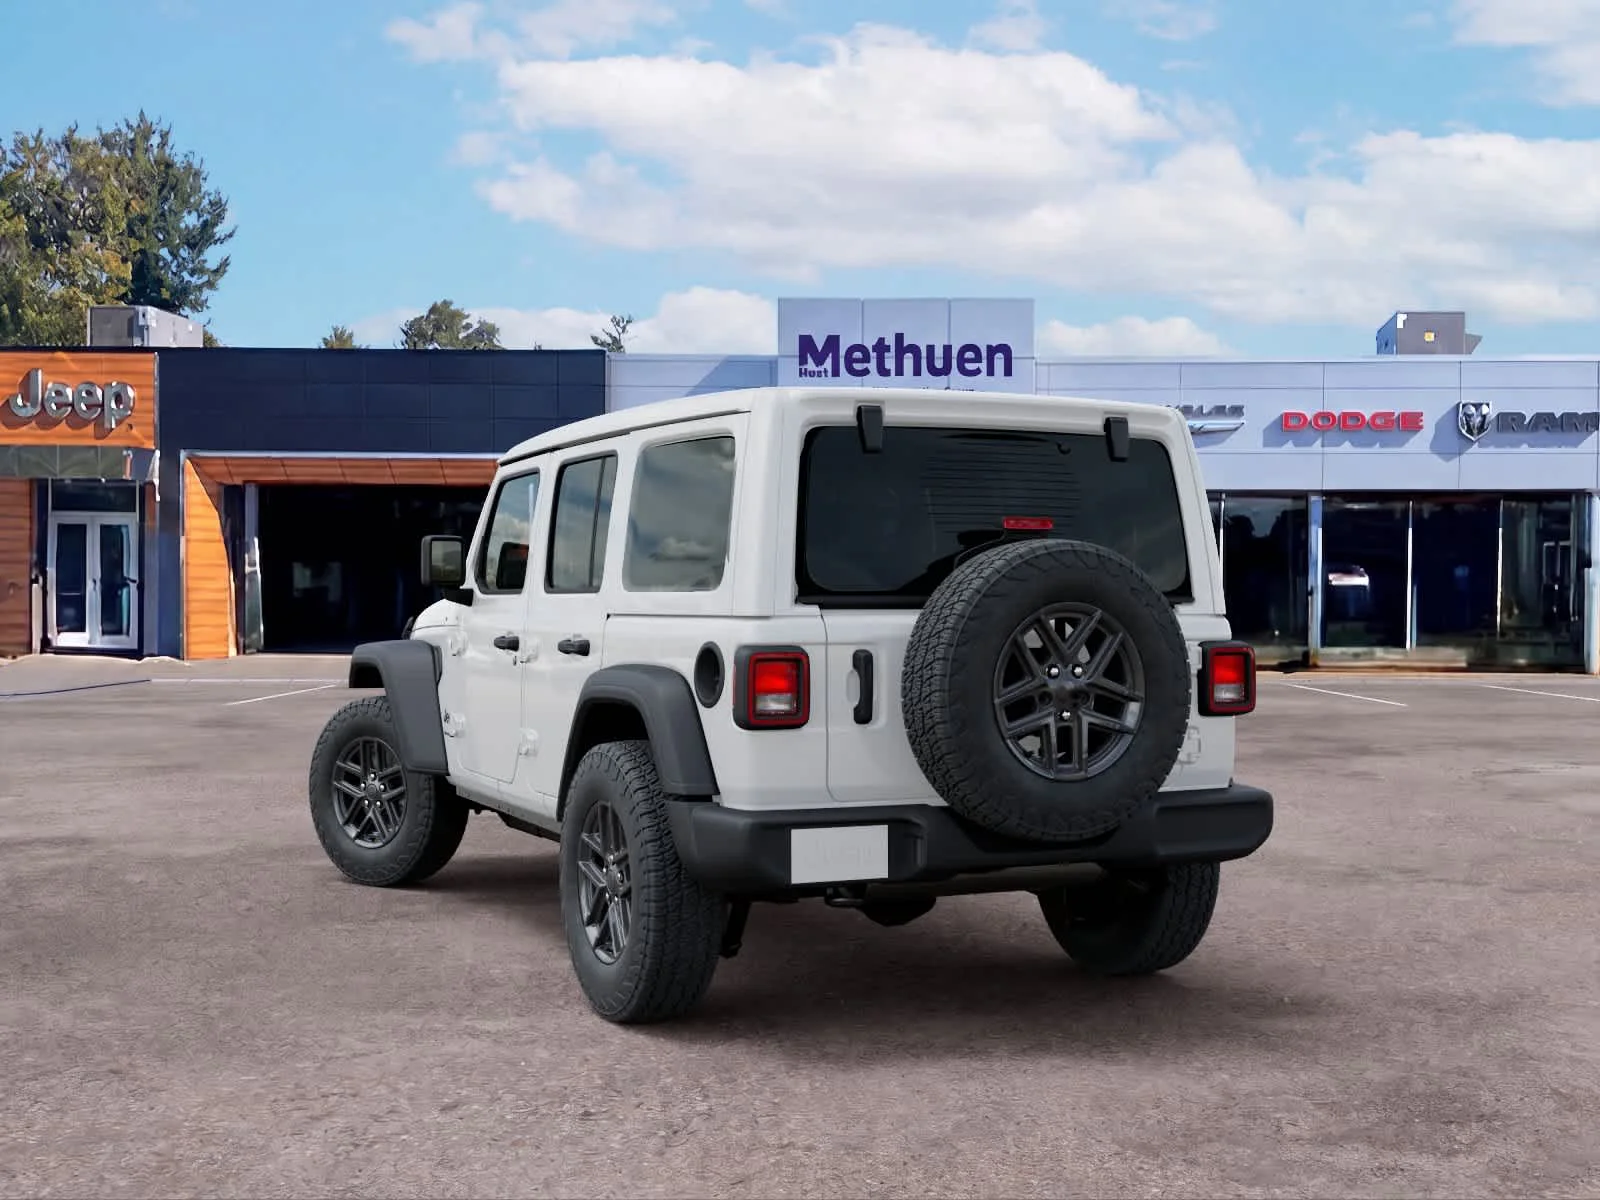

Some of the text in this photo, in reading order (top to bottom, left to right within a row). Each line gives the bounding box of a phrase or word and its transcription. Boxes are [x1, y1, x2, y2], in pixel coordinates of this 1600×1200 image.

[798, 333, 1013, 378] Methuen
[9, 368, 136, 429] Jeep
[1282, 411, 1424, 431] DODGE
[1497, 411, 1600, 433] RAM
